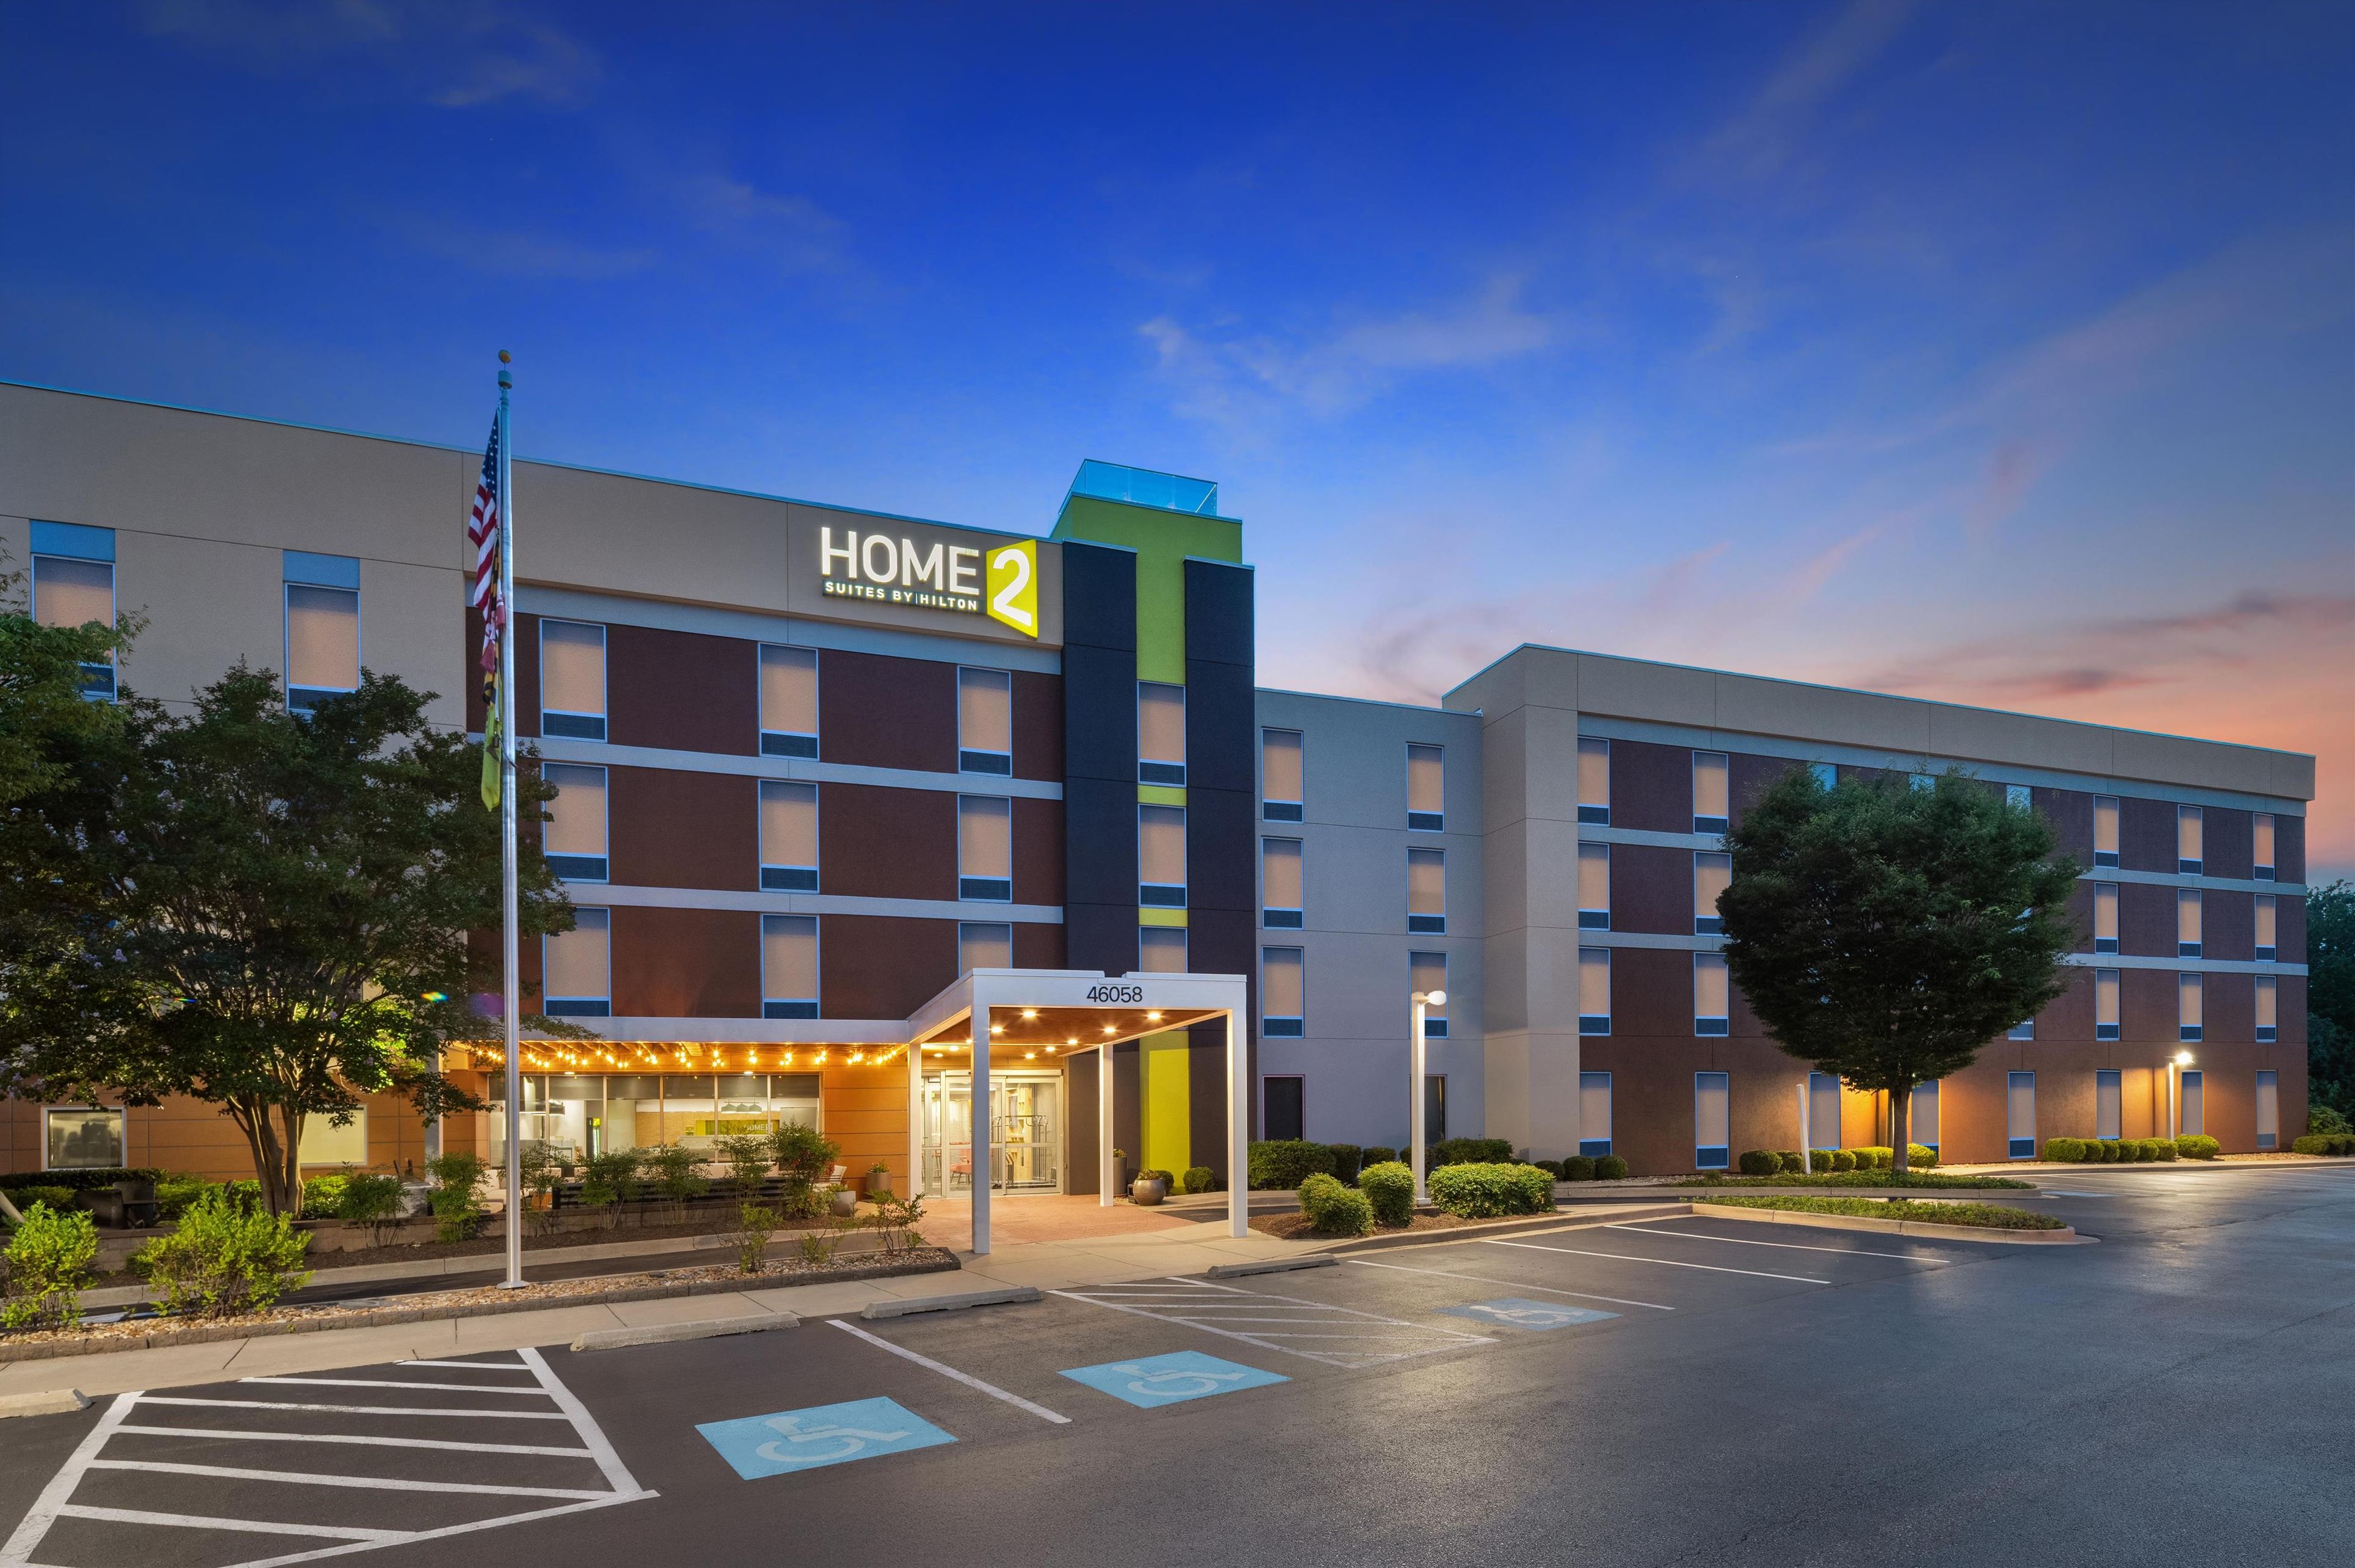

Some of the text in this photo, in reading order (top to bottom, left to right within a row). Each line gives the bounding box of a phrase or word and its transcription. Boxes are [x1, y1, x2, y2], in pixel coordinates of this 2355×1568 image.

[821, 527, 1032, 628] HOME 2
[826, 581, 978, 611] SUITES BY HILTON
[1086, 986, 1143, 1003] 46058
